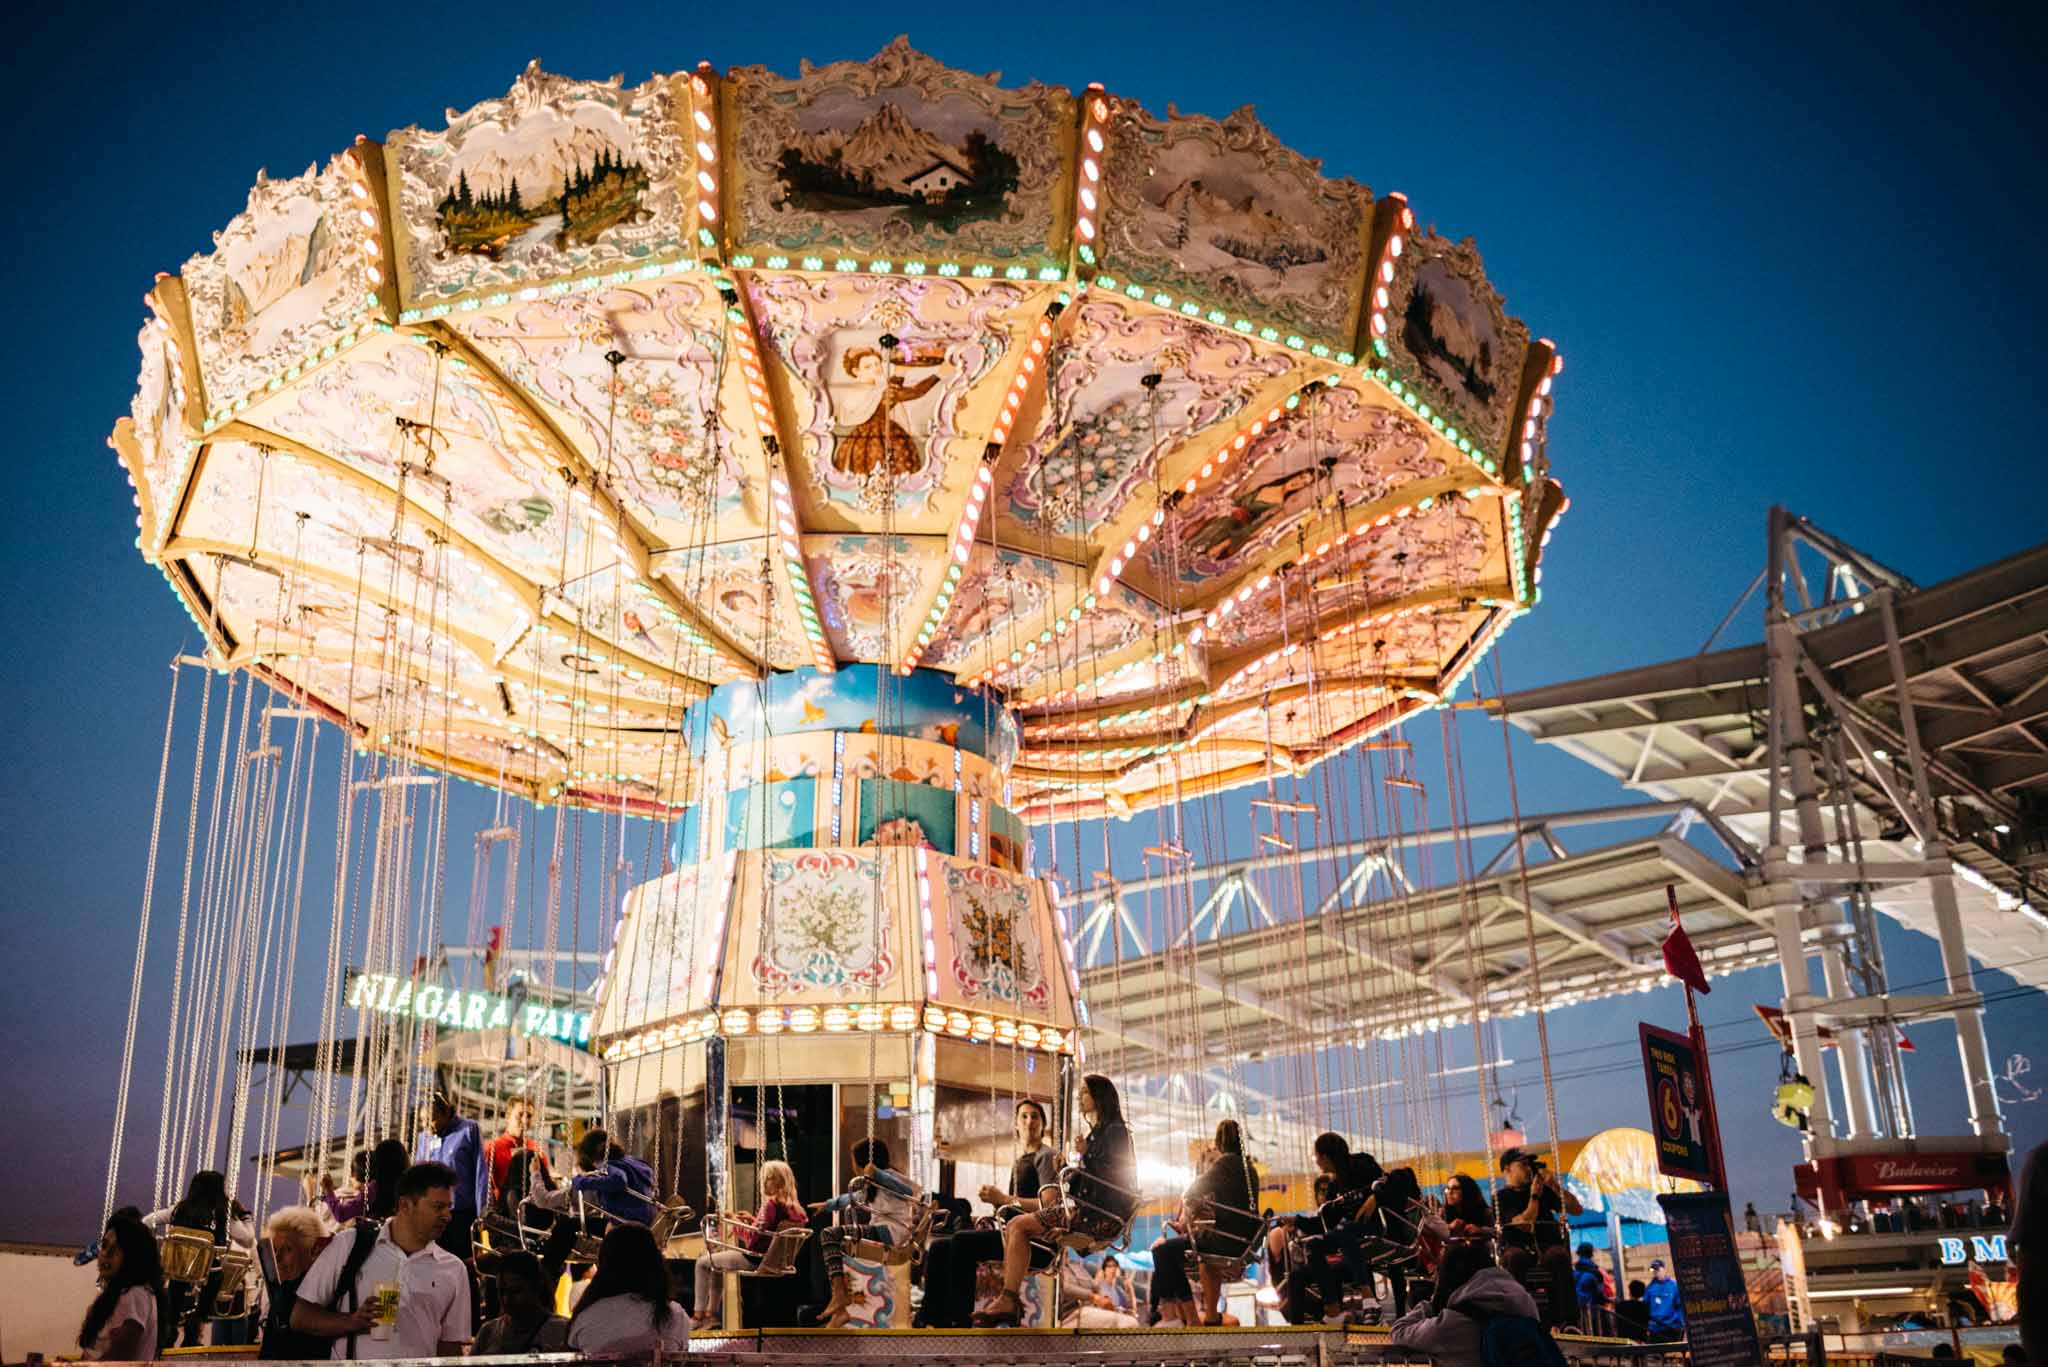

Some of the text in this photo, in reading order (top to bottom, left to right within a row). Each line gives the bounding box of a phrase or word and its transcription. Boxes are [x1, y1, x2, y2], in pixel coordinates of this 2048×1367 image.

[350, 974, 508, 1029] NIAGARA
[1664, 1087, 1677, 1130] 6
[1873, 1160, 1960, 1179] Budweiser
